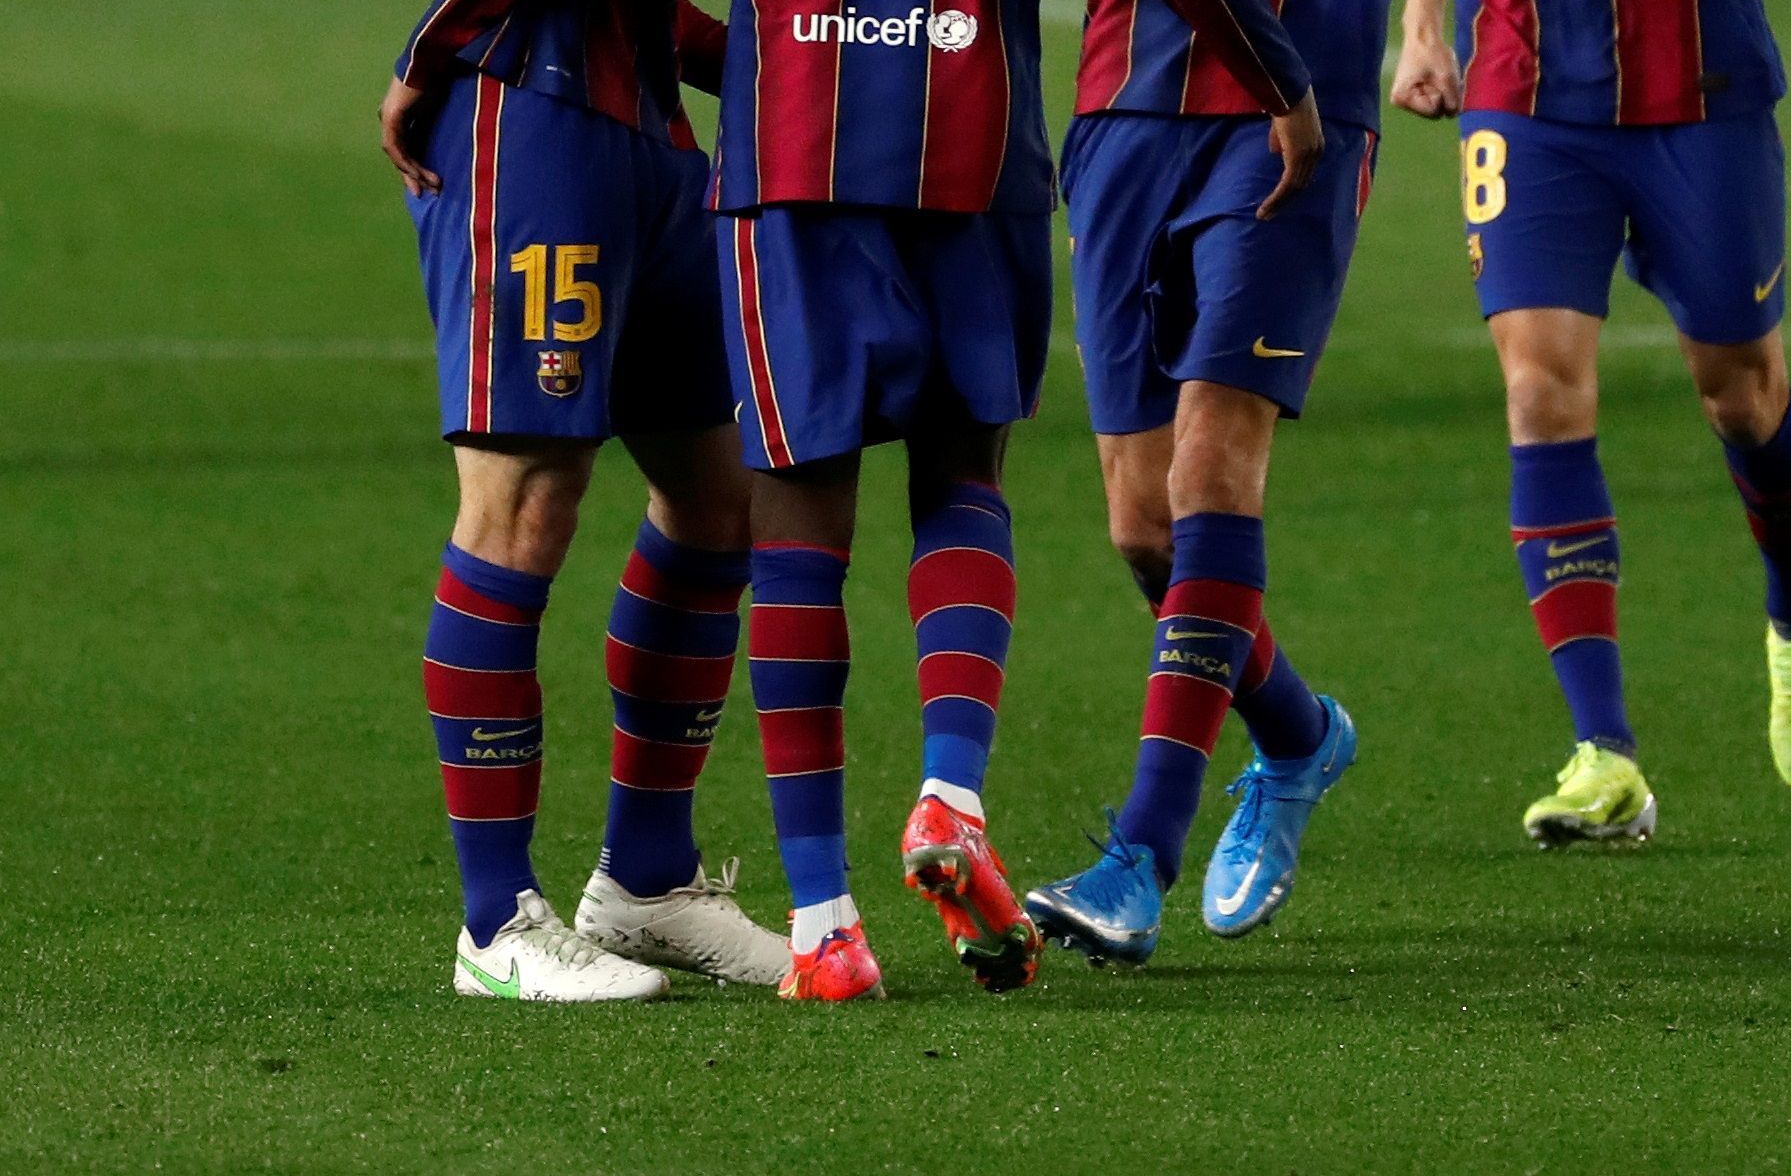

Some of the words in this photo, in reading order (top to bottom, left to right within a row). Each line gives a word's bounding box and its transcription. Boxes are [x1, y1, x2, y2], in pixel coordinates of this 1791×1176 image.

[793, 7, 924, 46] unicef
[1461, 129, 1508, 225] 8
[510, 243, 602, 342] 15
